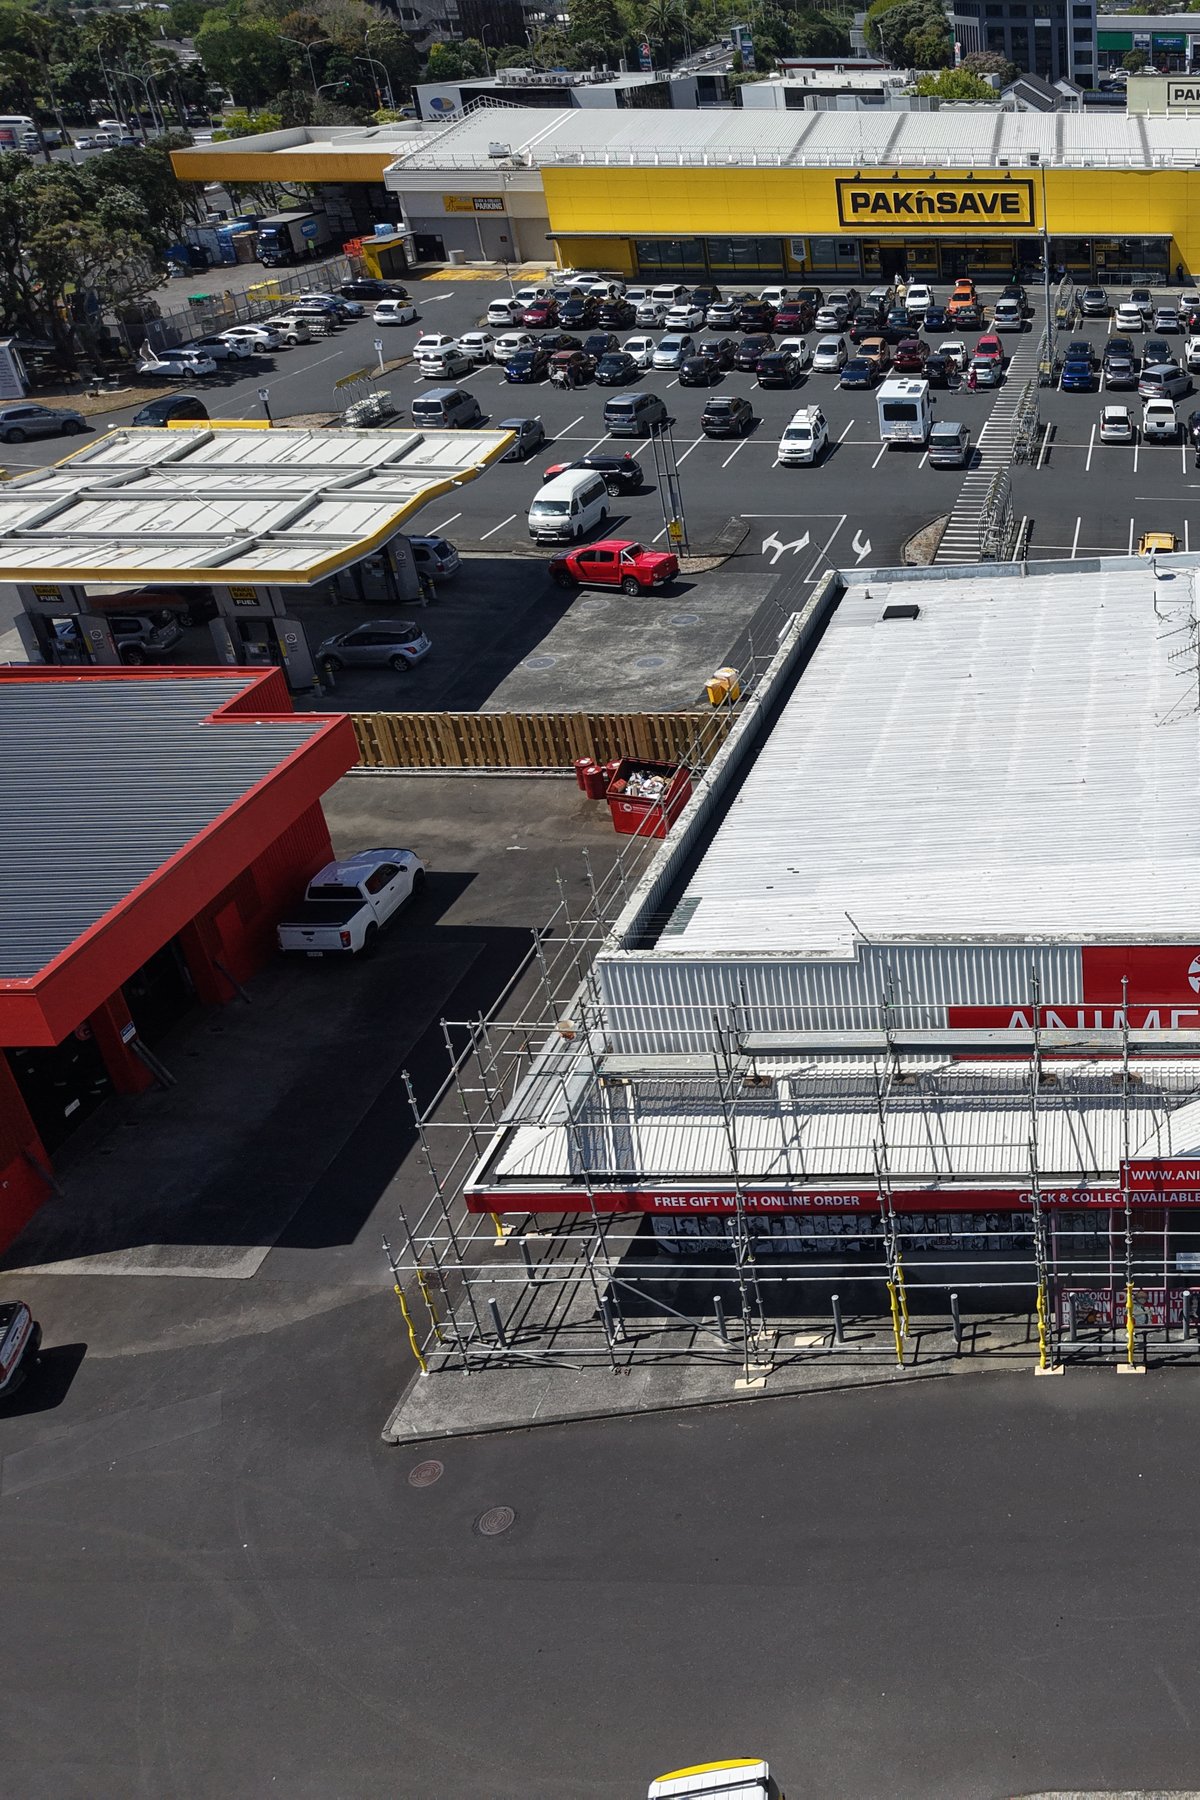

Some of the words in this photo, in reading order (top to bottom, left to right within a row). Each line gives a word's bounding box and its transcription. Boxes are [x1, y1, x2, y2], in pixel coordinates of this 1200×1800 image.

[475, 202, 503, 210] PARKING
[654, 1197, 687, 1207] FREE
[689, 1196, 719, 1207] GIFT
[722, 1196, 758, 1206] WTH
[760, 1196, 811, 1206] ONLINE
[813, 1195, 860, 1206] ORDER
[1019, 1193, 1057, 1203] CLCK
[1059, 1193, 1069, 1203] &
